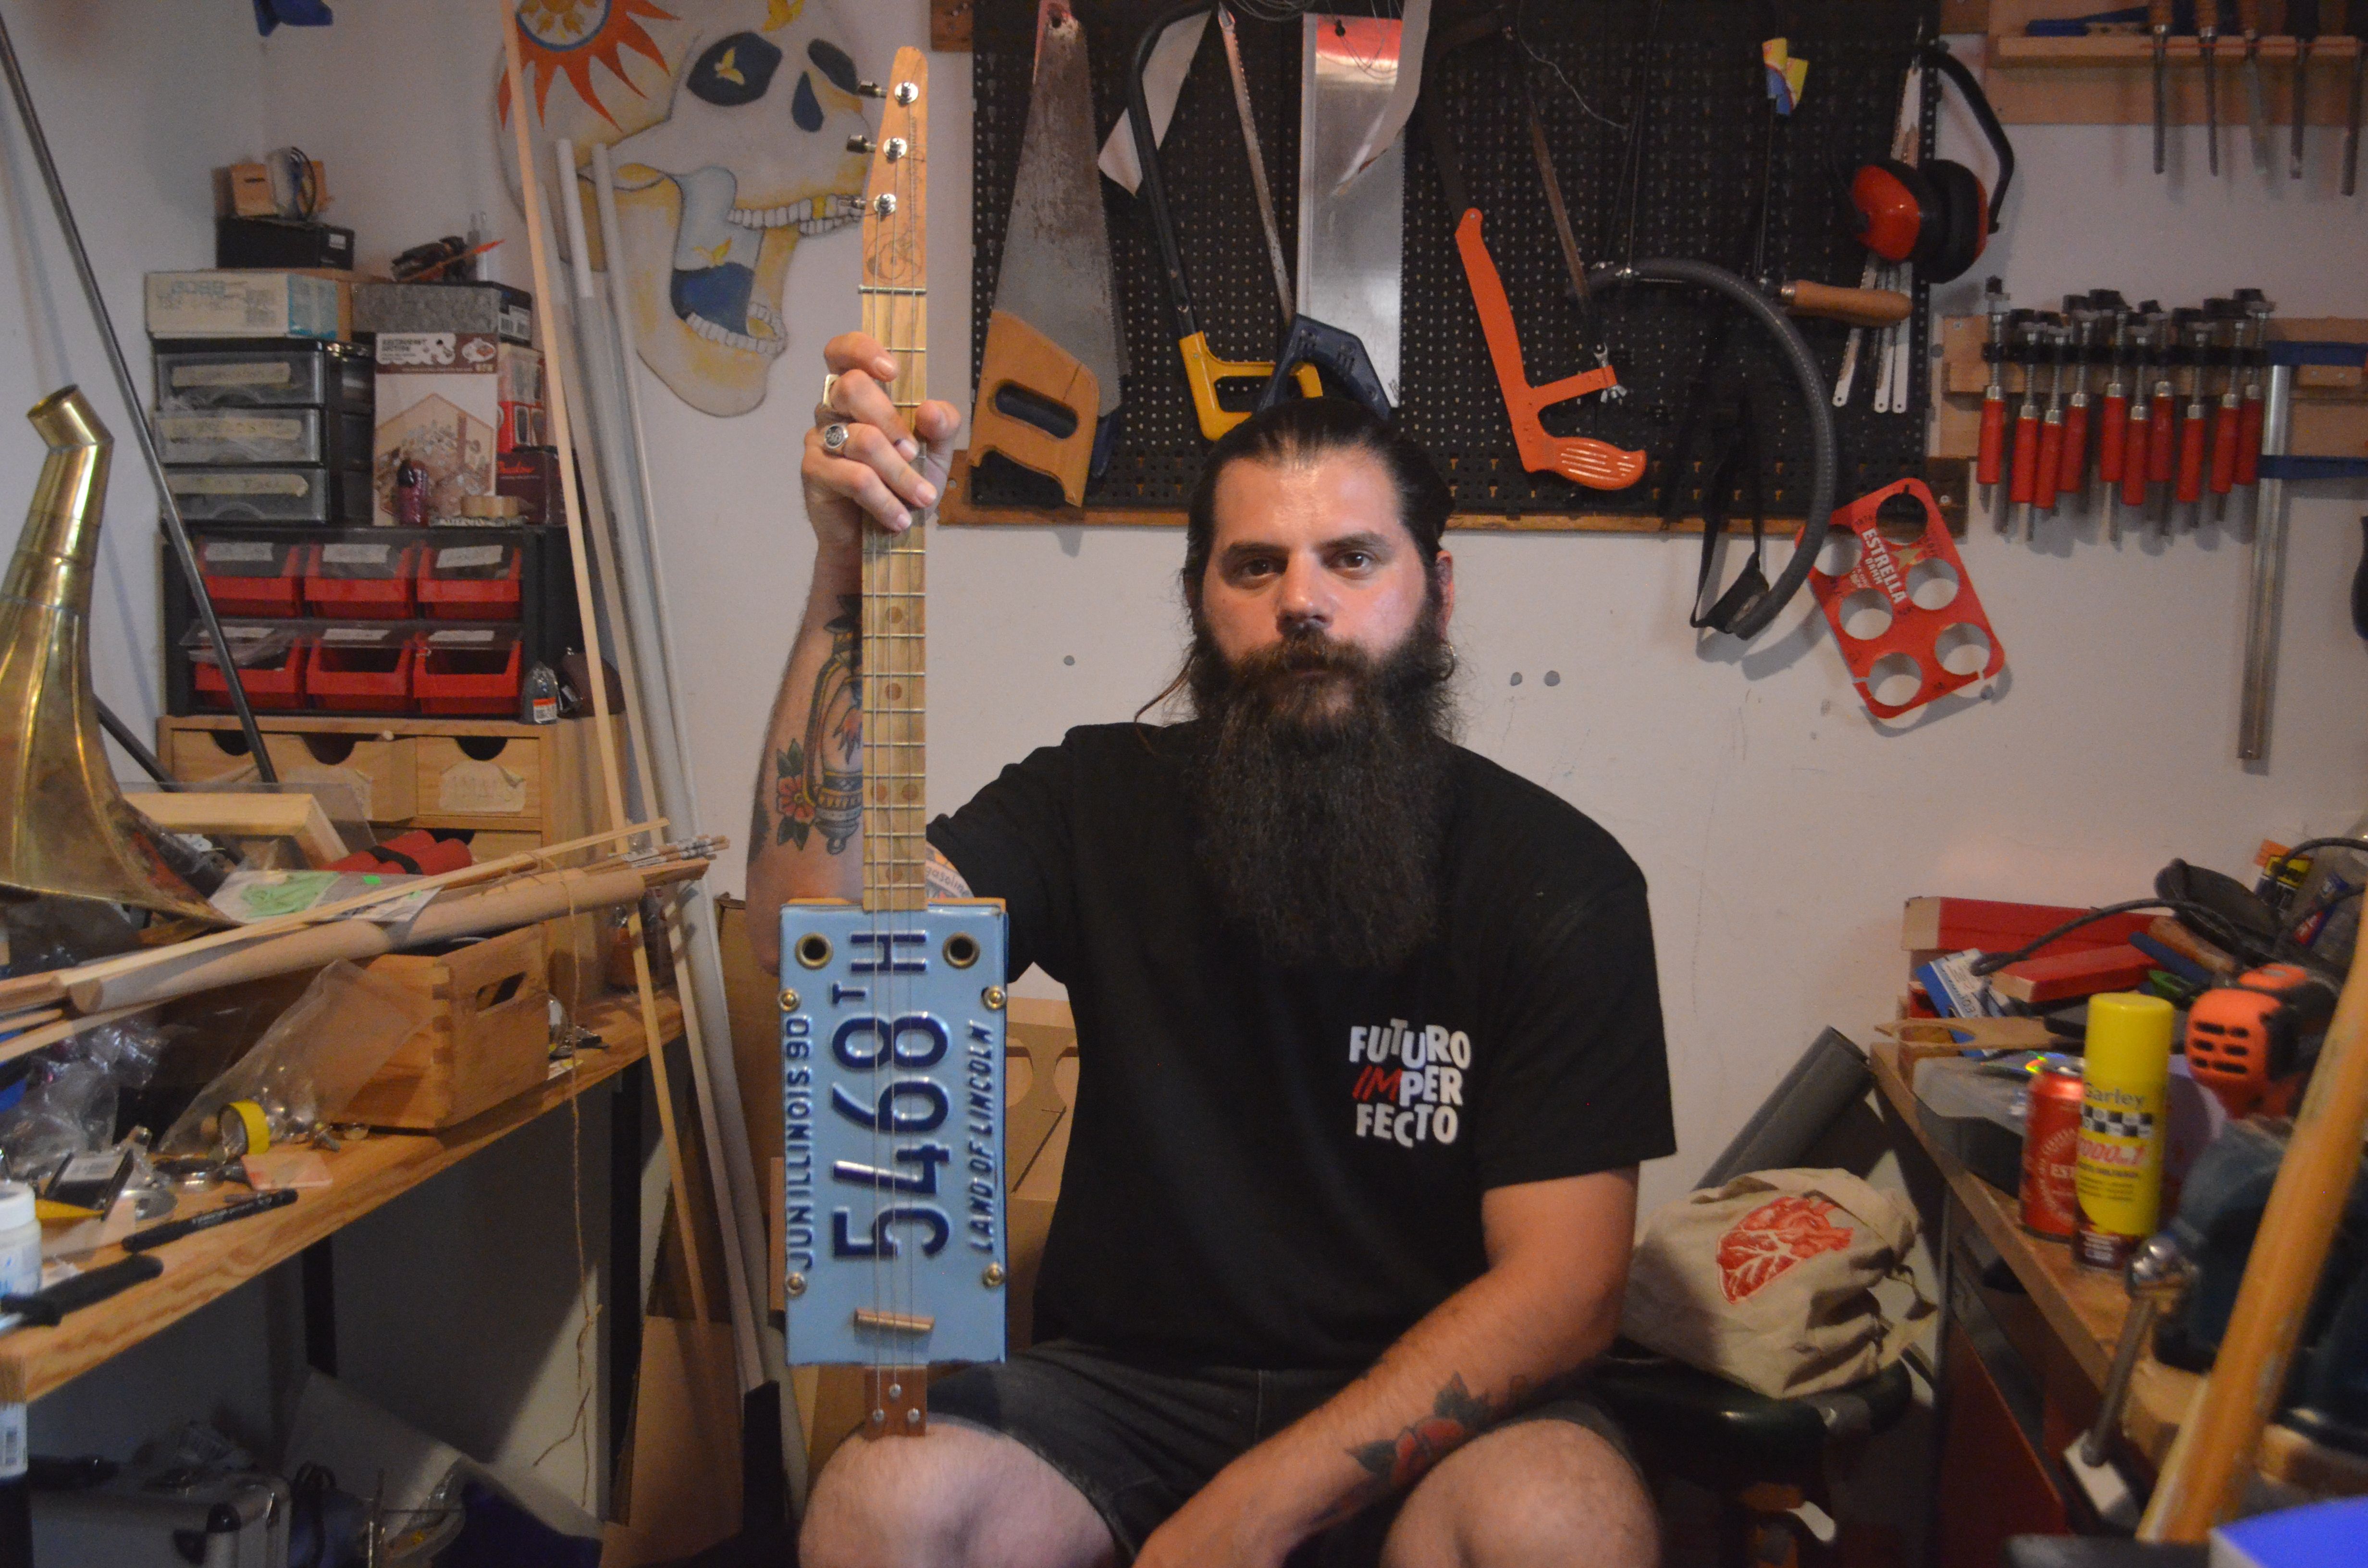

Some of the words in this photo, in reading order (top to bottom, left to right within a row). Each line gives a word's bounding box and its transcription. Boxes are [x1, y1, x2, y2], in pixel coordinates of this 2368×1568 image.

[1862, 527, 1907, 604] ESTRELLA
[1864, 557, 1883, 585] DAMM
[786, 1017, 810, 1058] 90
[1349, 1018, 1471, 1069] FUTURO
[969, 1025, 993, 1136] LINCOLN
[1352, 1065, 1464, 1107] IMPER
[787, 1070, 812, 1197] ILLINOIS
[1356, 1102, 1458, 1148] FECTO
[969, 1140, 993, 1173] OF
[787, 1205, 813, 1271] JUN
[969, 1182, 993, 1255] LAND
